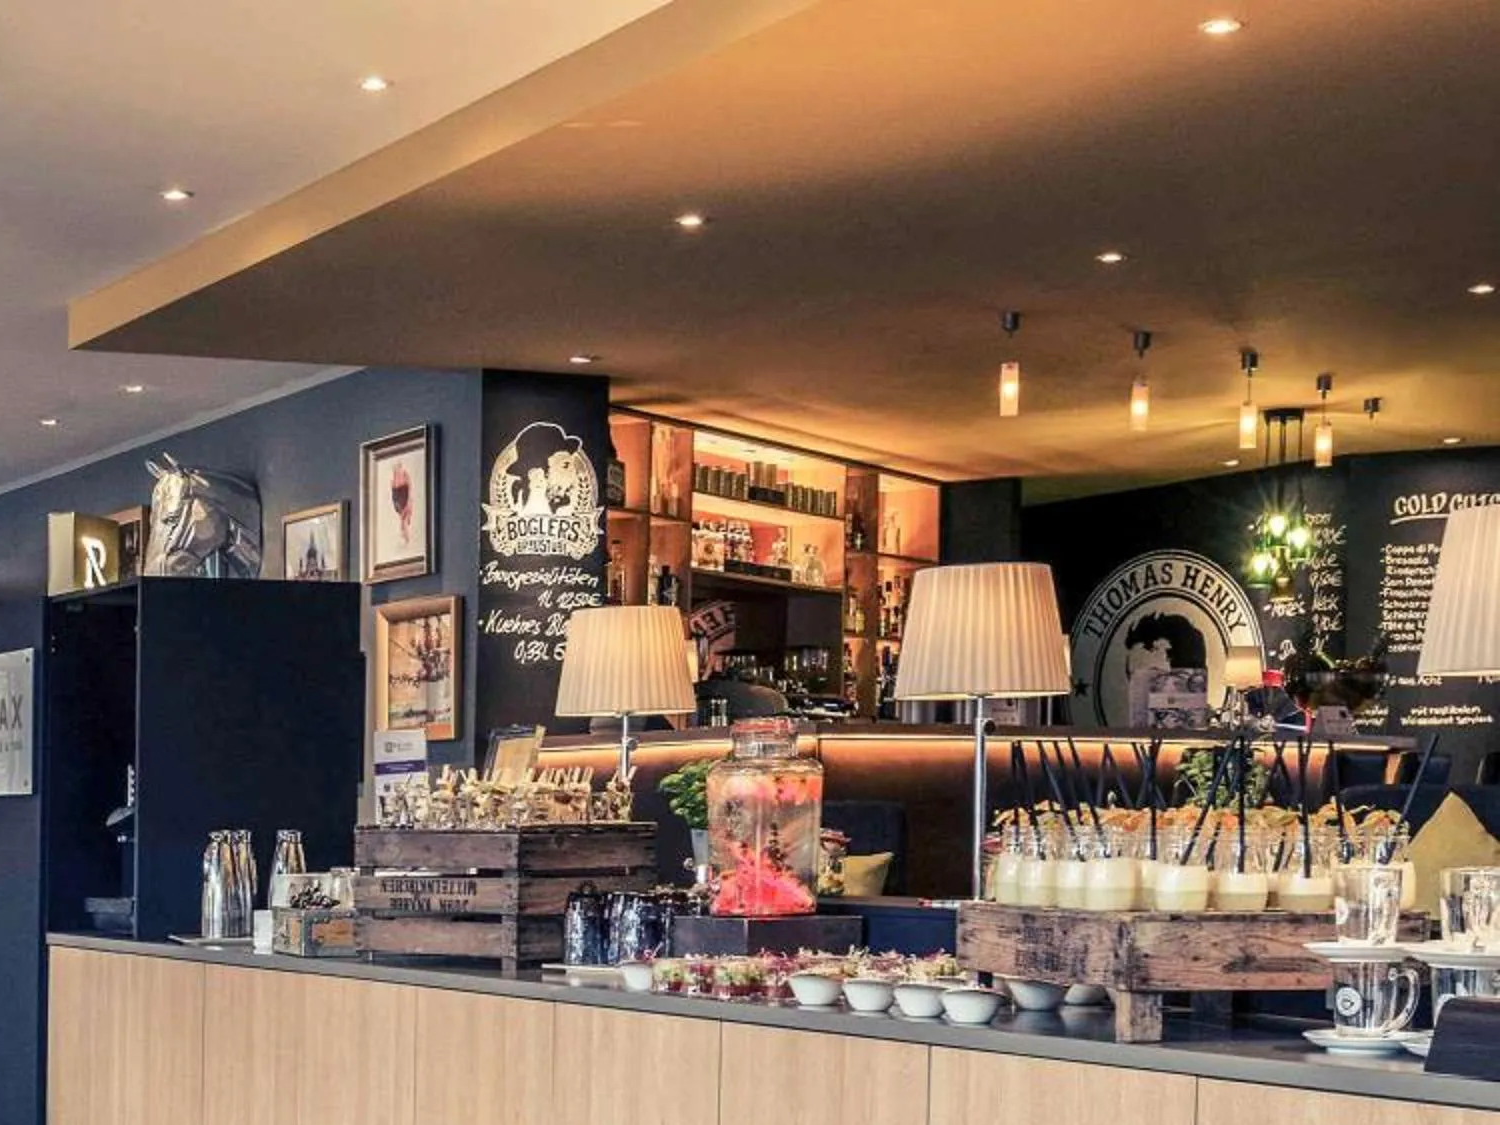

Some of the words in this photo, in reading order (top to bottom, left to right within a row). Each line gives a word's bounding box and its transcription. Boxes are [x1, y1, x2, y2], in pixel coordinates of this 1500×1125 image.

[81, 536, 106, 589] R
[1083, 563, 1173, 639] THOMAS
[1181, 565, 1247, 632] HENRY
